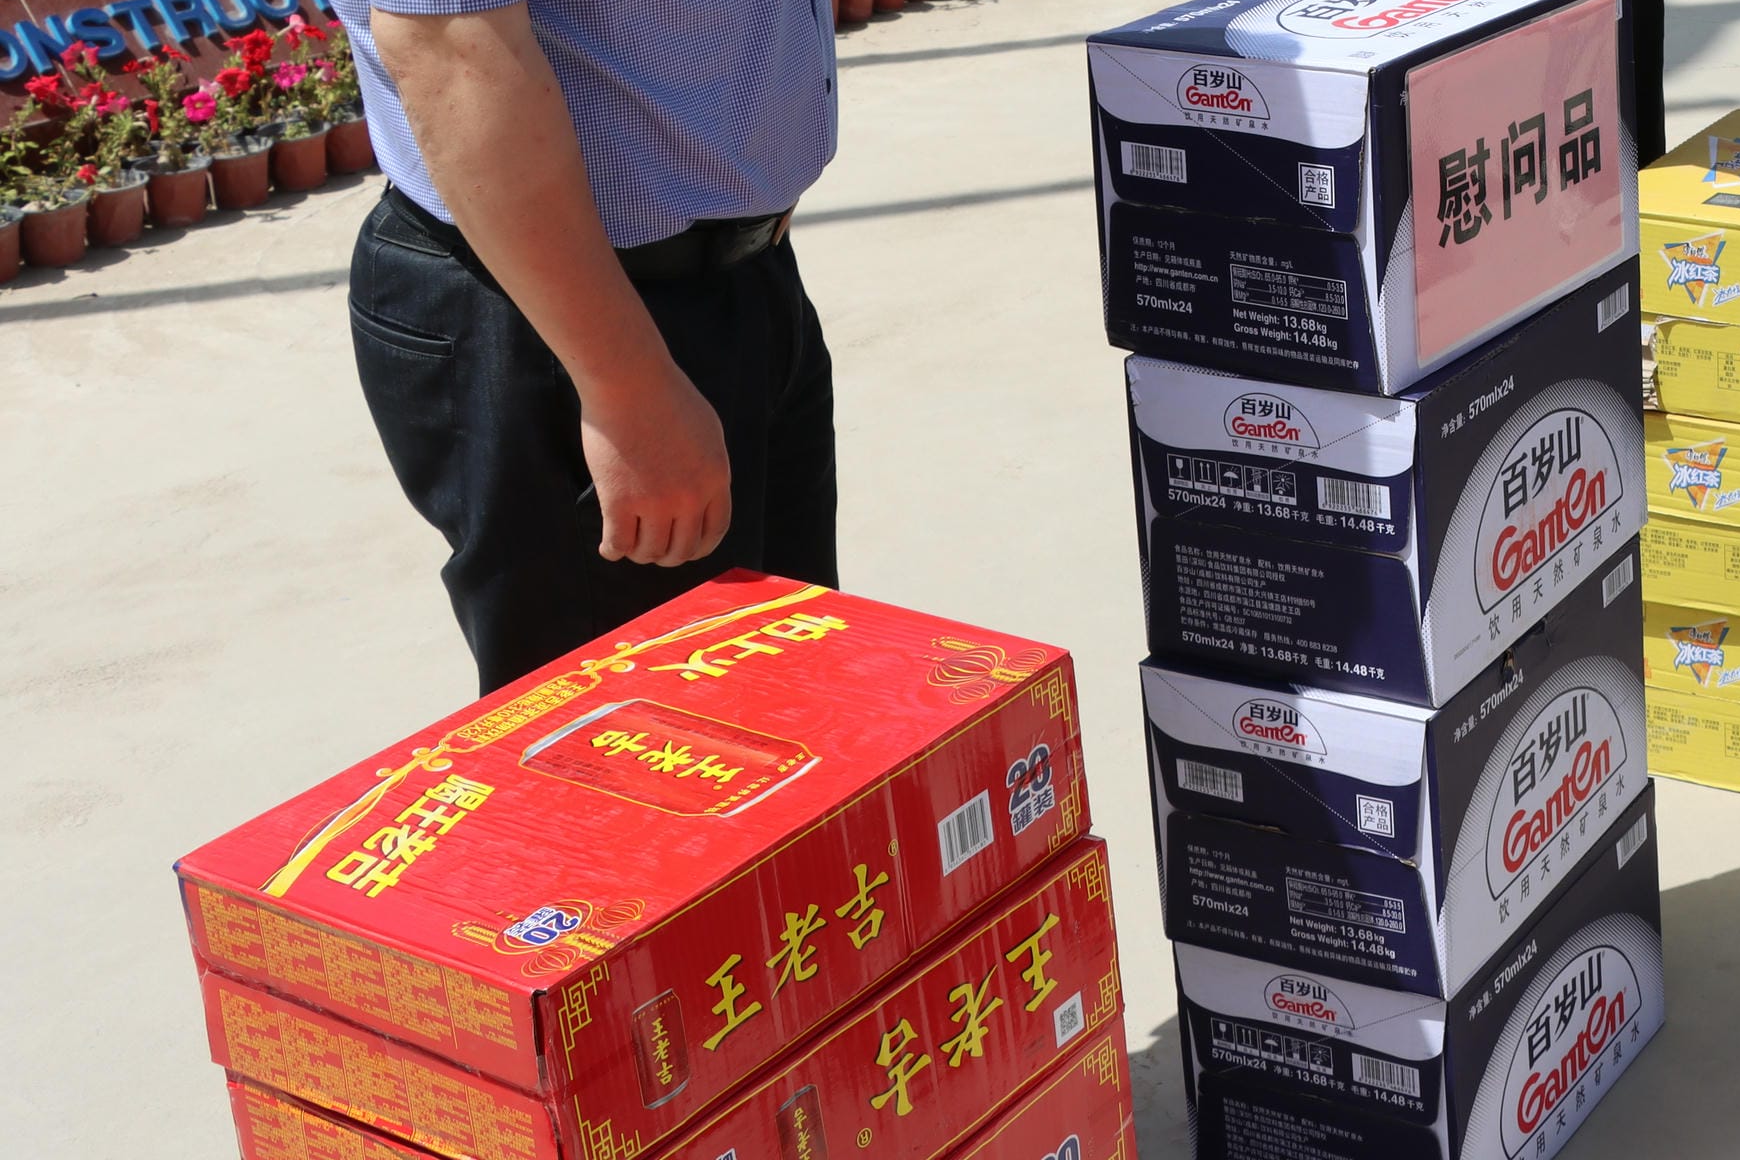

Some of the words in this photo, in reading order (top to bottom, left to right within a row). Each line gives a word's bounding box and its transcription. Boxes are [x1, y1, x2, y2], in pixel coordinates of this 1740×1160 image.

[1193, 68, 1242, 90] 百岁山
[1186, 85, 1252, 112] Ganten
[1304, 169, 1329, 186] 合格
[1437, 88, 1601, 248] 慰问品
[1304, 185, 1329, 201] 产品
[1668, 258, 1720, 289] 冰红茶
[1136, 294, 1193, 314] 570mlx24
[1233, 308, 1247, 320] Net
[1248, 310, 1280, 325] Weight:
[1283, 315, 1327, 334] 13.68kg
[1233, 323, 1259, 336] Gross
[1260, 326, 1292, 341] Weight:
[1293, 330, 1338, 351] 14.48kg
[1241, 398, 1291, 420] 百岁山
[1468, 375, 1514, 422] 570mlx24
[1232, 416, 1300, 441] Ganten
[1501, 416, 1582, 520] 百岁山
[1670, 463, 1721, 494] 冰红茶
[1168, 489, 1226, 509] 570mlx24
[1492, 467, 1607, 592] Ganten
[1488, 509, 1622, 641] 饮用天然矿泉水
[647, 611, 848, 682] 怕上火
[1182, 631, 1235, 651] 570mlx24
[1674, 642, 1724, 671] 冰红茶
[1480, 669, 1524, 720] 570mlx24
[1249, 702, 1299, 727] 百岁山
[1239, 716, 1307, 746] Ganten
[591, 730, 744, 783] 王老吉
[1511, 693, 1588, 807] 百岁山
[1006, 743, 1053, 814] 20
[1011, 786, 1055, 835] 罐装
[1363, 802, 1389, 817] 合格
[1502, 740, 1611, 873] Ganten
[323, 772, 496, 900] 喝王老吉
[1363, 816, 1389, 831] 产品
[1499, 773, 1625, 924] 饮用天然矿泉水
[1192, 894, 1249, 917] 570mlx24
[521, 910, 581, 946] 20
[1289, 915, 1304, 926] Net
[1305, 918, 1337, 934] Weight:
[1340, 925, 1385, 944] 13.68kg
[1290, 928, 1316, 941] Gross
[1317, 933, 1349, 949] Weight:
[1351, 940, 1396, 959] 14.48kg
[702, 863, 890, 1052] 王老吉
[1494, 939, 1538, 994] 570mlx24
[1280, 977, 1328, 1002] 百岁山
[871, 913, 1061, 1117] 王老吉
[1271, 992, 1337, 1021] Ganten
[1526, 951, 1603, 1070] 百岁山
[650, 1017, 675, 1086] 王老吉
[1212, 1048, 1267, 1071] 570mlx24
[1517, 990, 1626, 1134] Ganten
[1518, 1020, 1640, 1160] 用天然矿泉水
